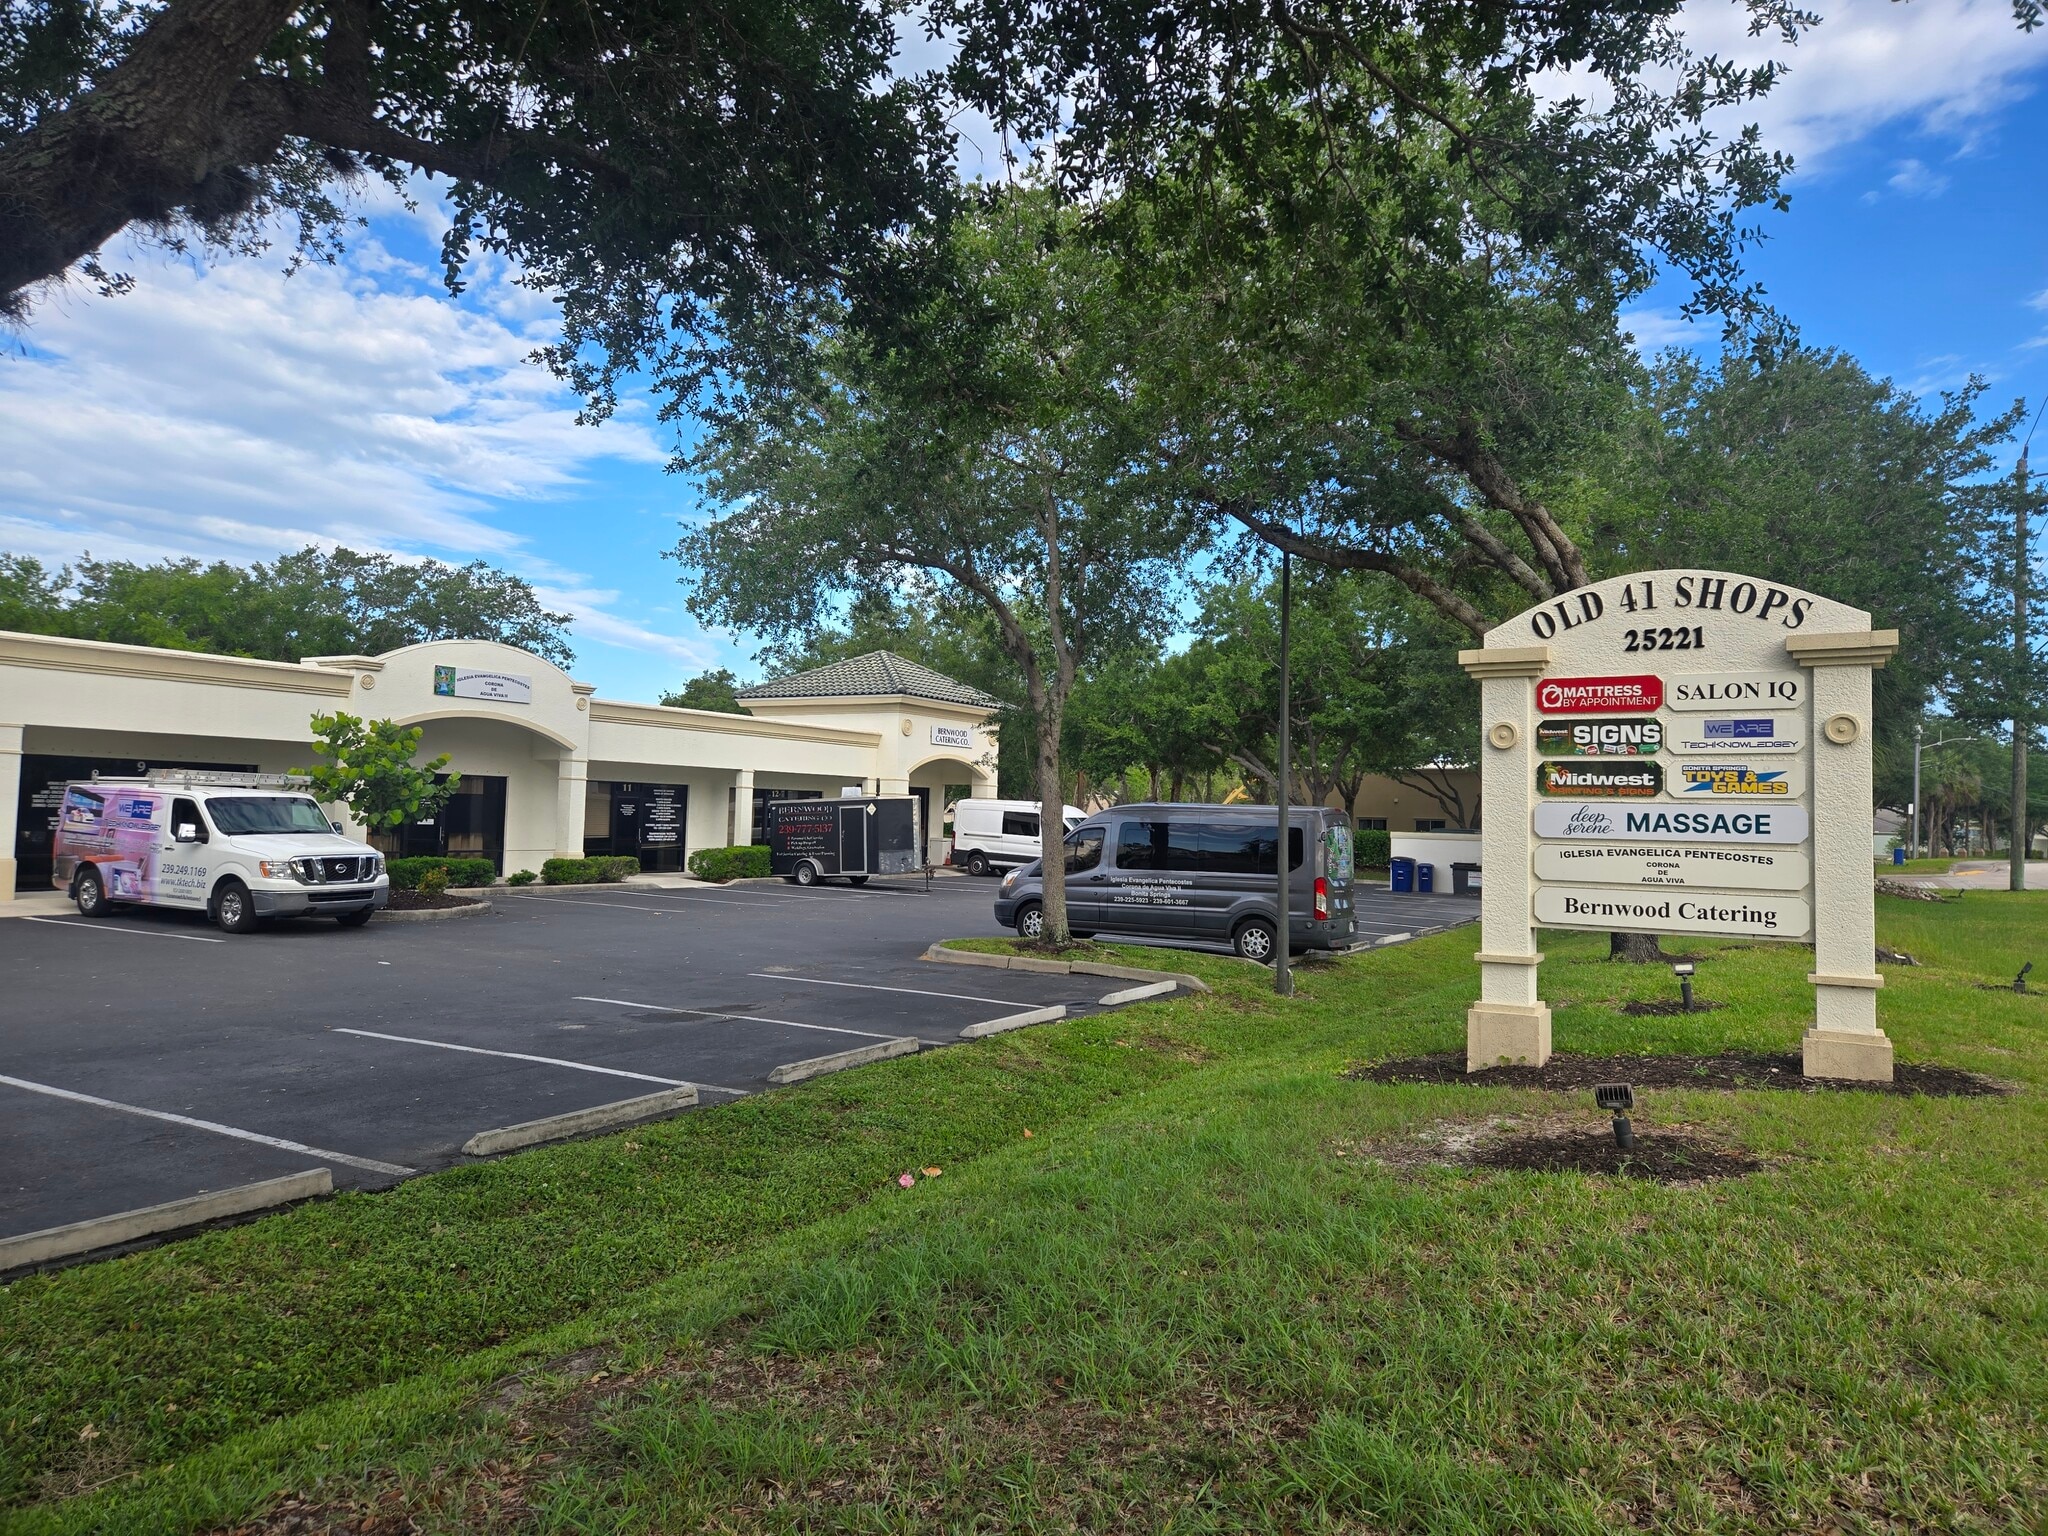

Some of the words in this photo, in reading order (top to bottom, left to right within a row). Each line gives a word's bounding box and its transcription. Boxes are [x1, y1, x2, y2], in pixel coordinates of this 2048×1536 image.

[1531, 591, 1604, 639] OLD
[1620, 580, 1659, 613] 41
[1675, 576, 1814, 629] SHOPS
[1625, 626, 1706, 652] 25221
[1563, 685, 1642, 698] MATTRESS
[1677, 682, 1760, 701] SALON
[1768, 681, 1798, 701] IQ
[1563, 698, 1576, 708] BY
[1579, 696, 1658, 707] APPOINTMENT
[937, 727, 968, 738] BERNWOOD
[1573, 724, 1660, 744] SIGNS
[1706, 724, 1732, 734] WE
[1735, 723, 1771, 733] ARE
[935, 735, 960, 745] CATERING
[137, 761, 145, 771] 9
[1550, 773, 1655, 786] Midwest
[1683, 770, 1739, 783] TOYS
[1744, 770, 1758, 783] &
[623, 783, 631, 791] 11
[1619, 787, 1655, 795] SIGNS
[1712, 782, 1788, 794] GAMES
[779, 806, 833, 814] BERNWOOD
[1570, 805, 1612, 826] deep
[778, 815, 820, 823] CATERING
[1626, 812, 1771, 835] MASSAGE
[1563, 822, 1614, 837] serene
[1560, 849, 1603, 859] IGLESIA
[1607, 848, 1681, 858] EVANGELICA
[1685, 850, 1774, 865] PENTECOSTES
[161, 863, 207, 877] 239.249.1169
[160, 877, 206, 889] www.tktech.biz
[1129, 876, 1158, 884] Evangelica
[1563, 897, 1670, 918] Bernwood
[1678, 902, 1777, 928] Catering
